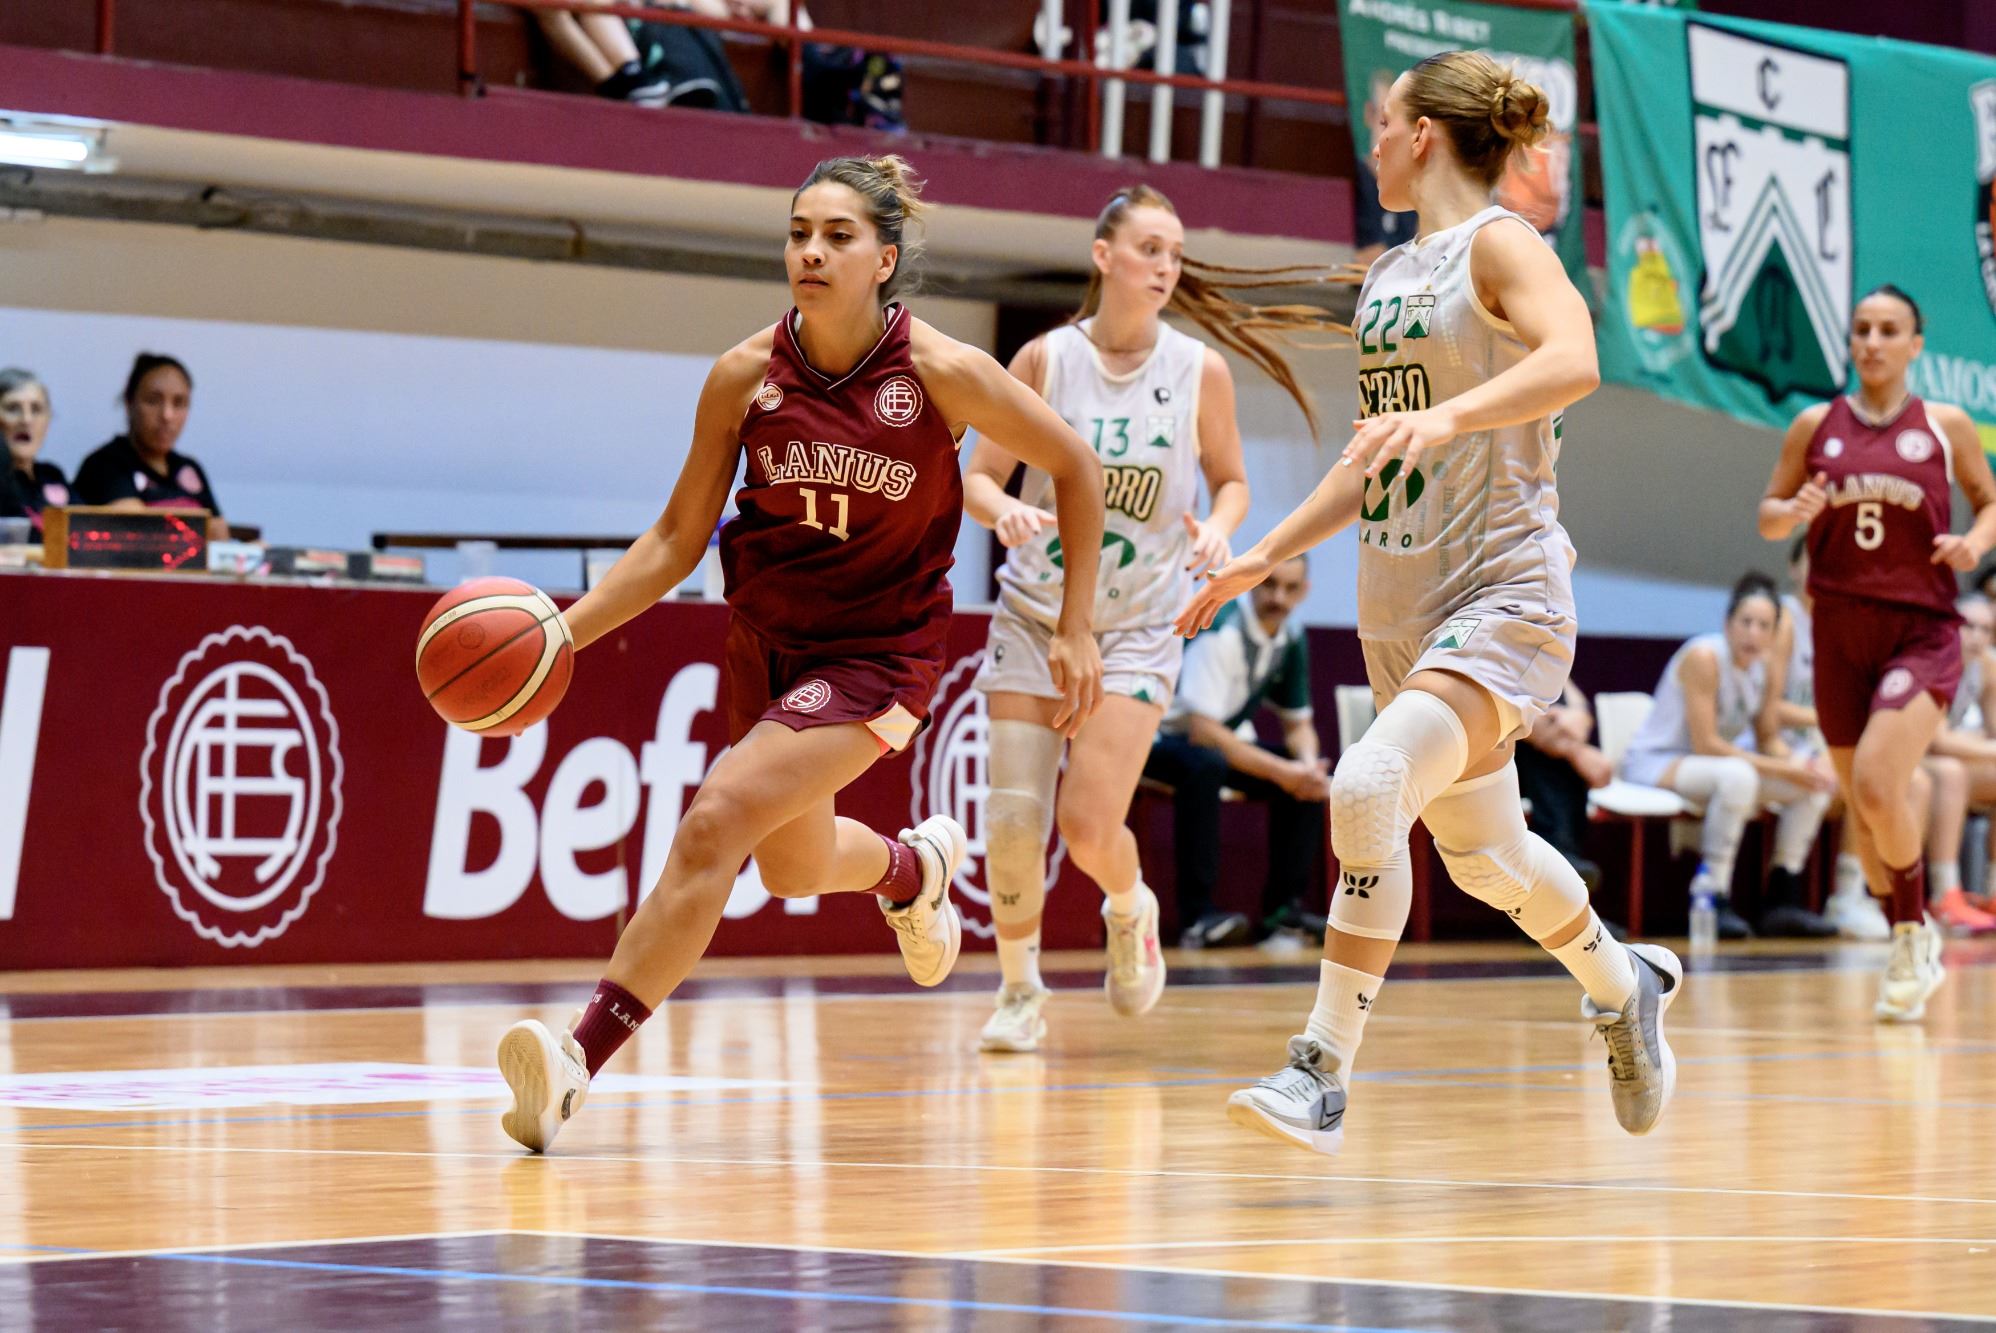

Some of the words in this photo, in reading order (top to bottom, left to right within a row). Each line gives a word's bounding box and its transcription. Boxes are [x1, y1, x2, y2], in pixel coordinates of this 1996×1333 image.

[1361, 296, 1402, 355] 22
[1091, 417, 1130, 457] 13
[757, 441, 917, 501] LANUS
[798, 487, 850, 542] 11
[1854, 502, 1885, 550] 5
[423, 663, 819, 919] Bef
